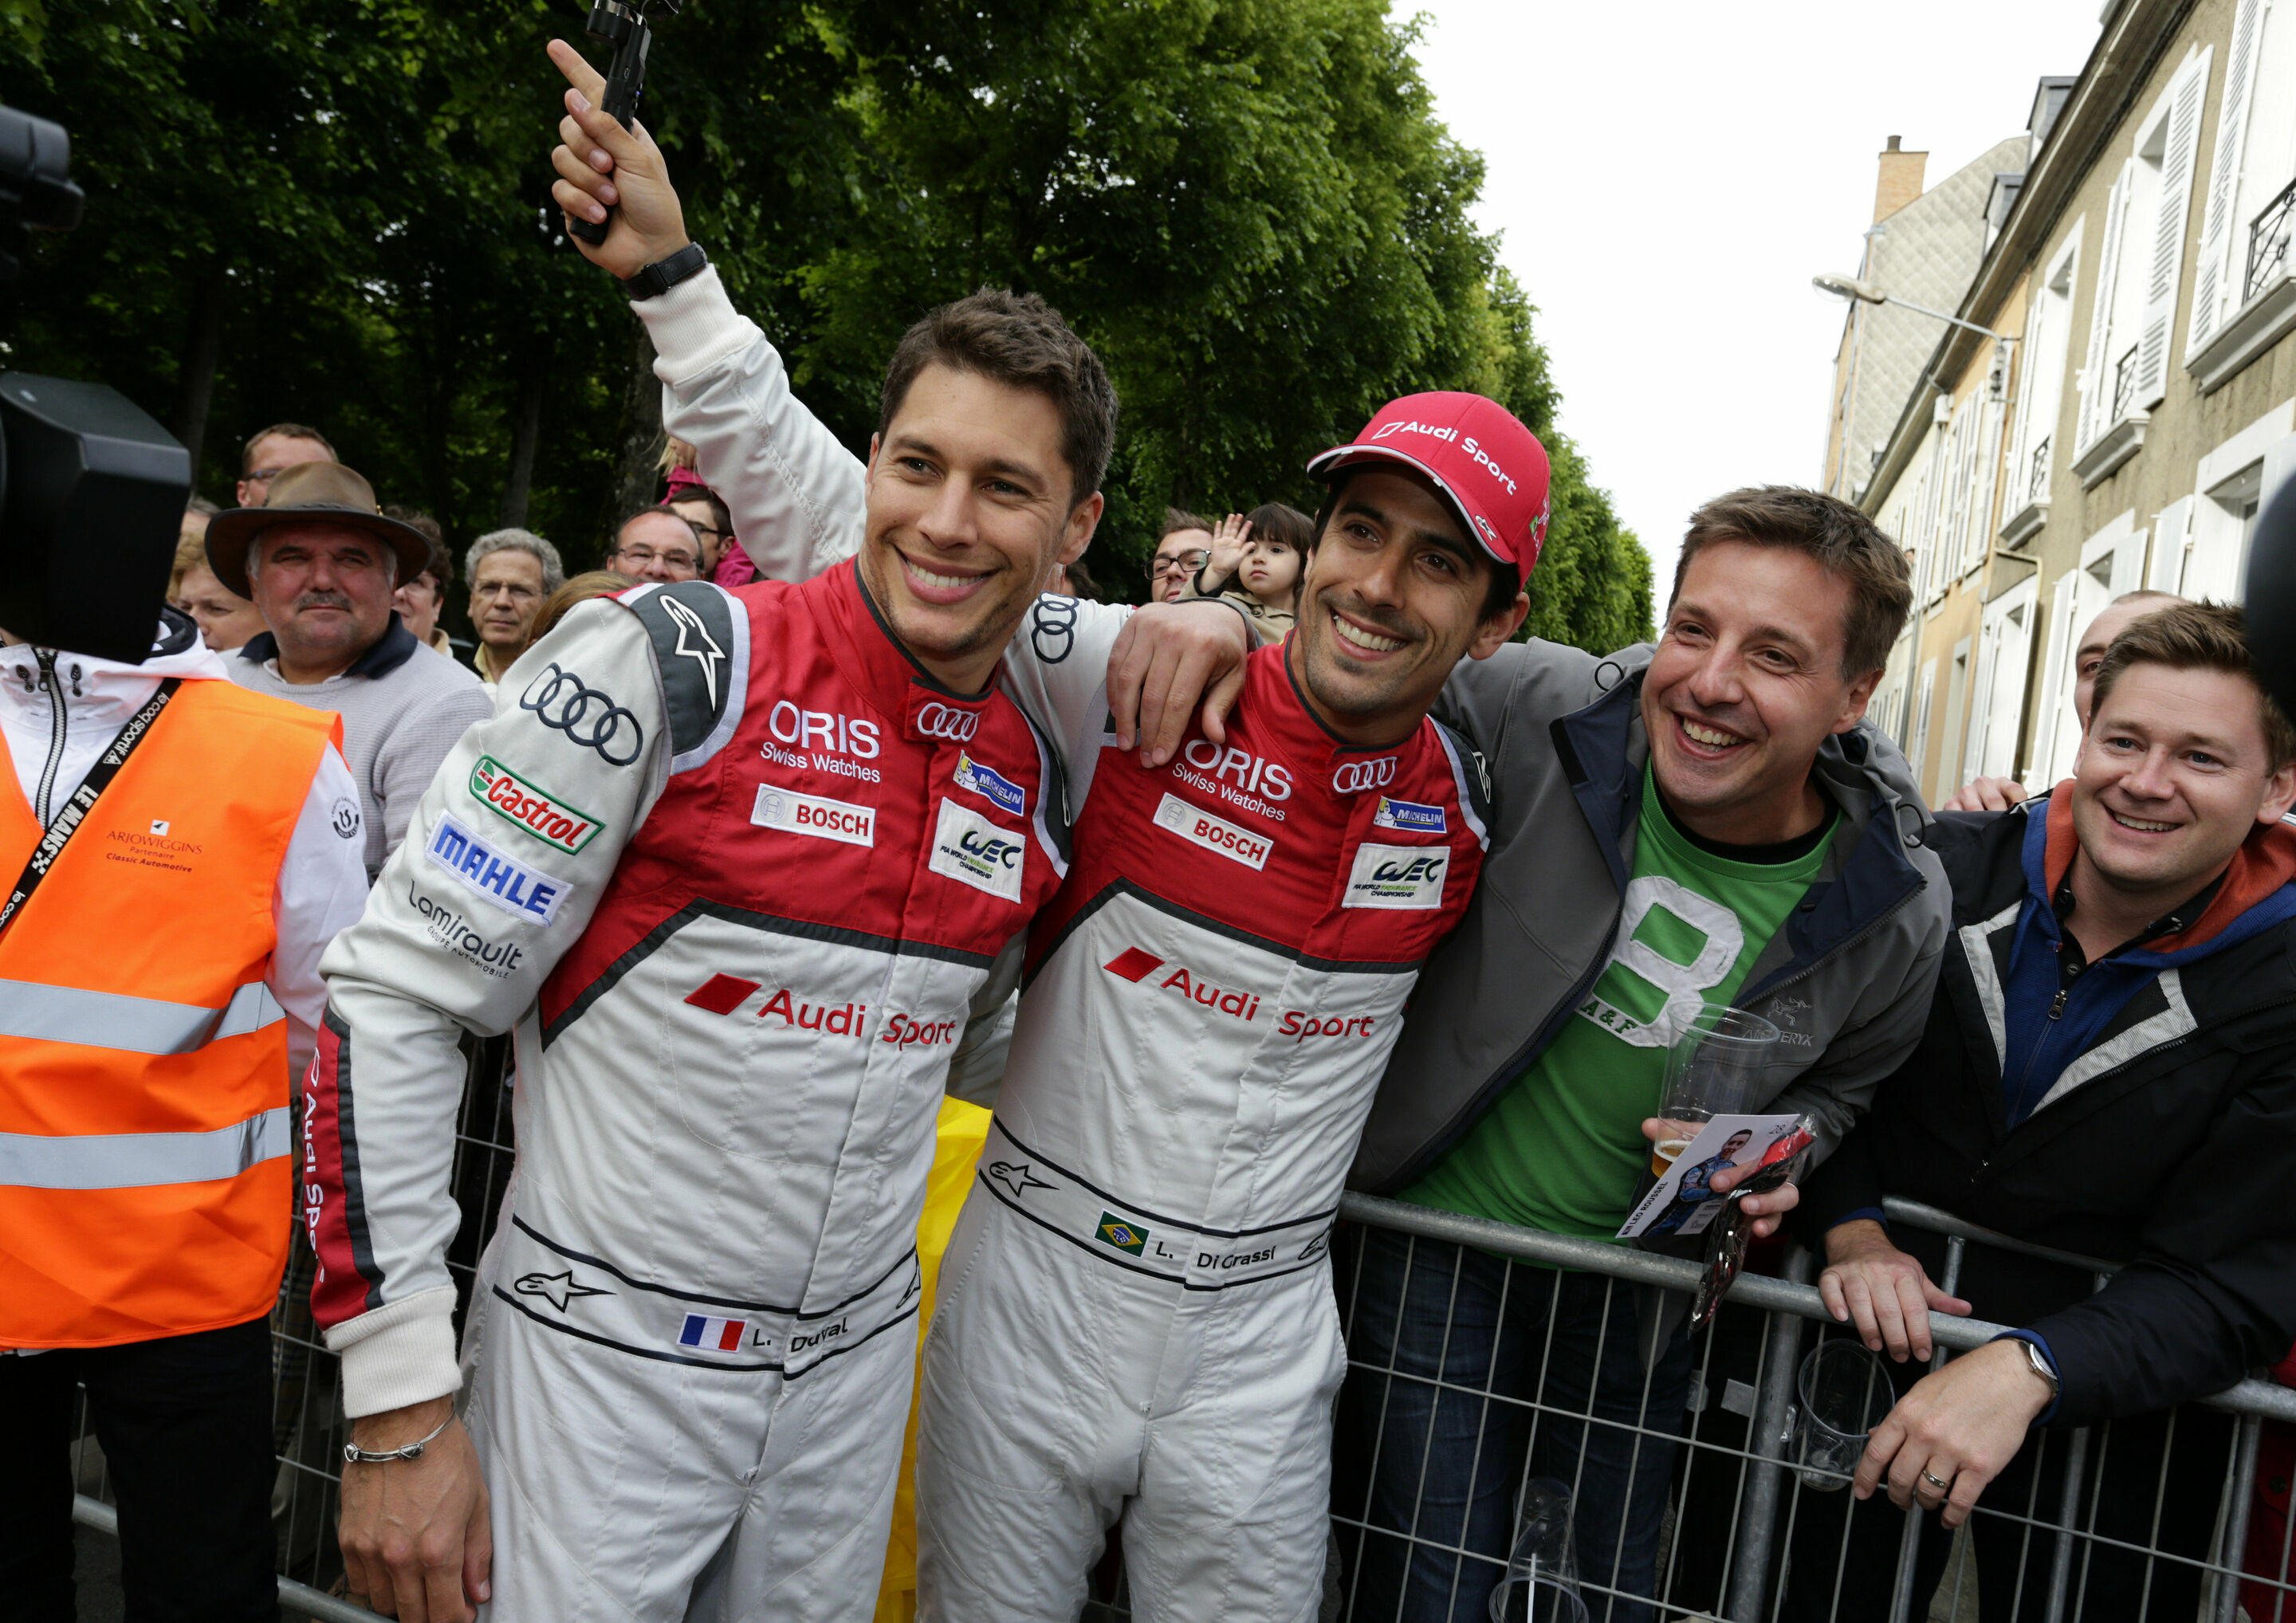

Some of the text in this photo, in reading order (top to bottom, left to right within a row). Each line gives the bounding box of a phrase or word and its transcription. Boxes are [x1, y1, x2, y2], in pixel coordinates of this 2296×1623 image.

[1400, 422, 1518, 496] Audi Sport
[114, 692, 171, 756] le coq sportif
[769, 700, 880, 759] ORIS
[761, 741, 881, 783] Swiss Watches
[1185, 740, 1294, 801] ORIS
[74, 784, 99, 808] LE
[488, 776, 588, 847] Castrol
[1172, 763, 1286, 821] Swiss Watches
[796, 804, 869, 837] BOSCH
[1397, 809, 1442, 823] MICHELIN
[107, 831, 202, 855] ARJOWIGGINS
[130, 846, 175, 859] Partenaire
[950, 849, 967, 861] WORLD
[961, 830, 1022, 869] WEC
[1193, 819, 1265, 862] BOSCH
[106, 852, 192, 873] Classic Automotive
[434, 823, 556, 914] MAHLE
[1373, 858, 1445, 882] WEC
[12, 890, 26, 902] le
[427, 925, 509, 979] GROUPE AUTOMOBILE
[757, 989, 957, 1051] Audi Sport
[1161, 968, 1374, 1043] Audi Sport
[304, 1092, 316, 1173] Audi
[1641, 1181, 1669, 1211] ROUSSEL
[1155, 1241, 1277, 1270] L. Di Grassi
[753, 1318, 848, 1353] L. Duval
